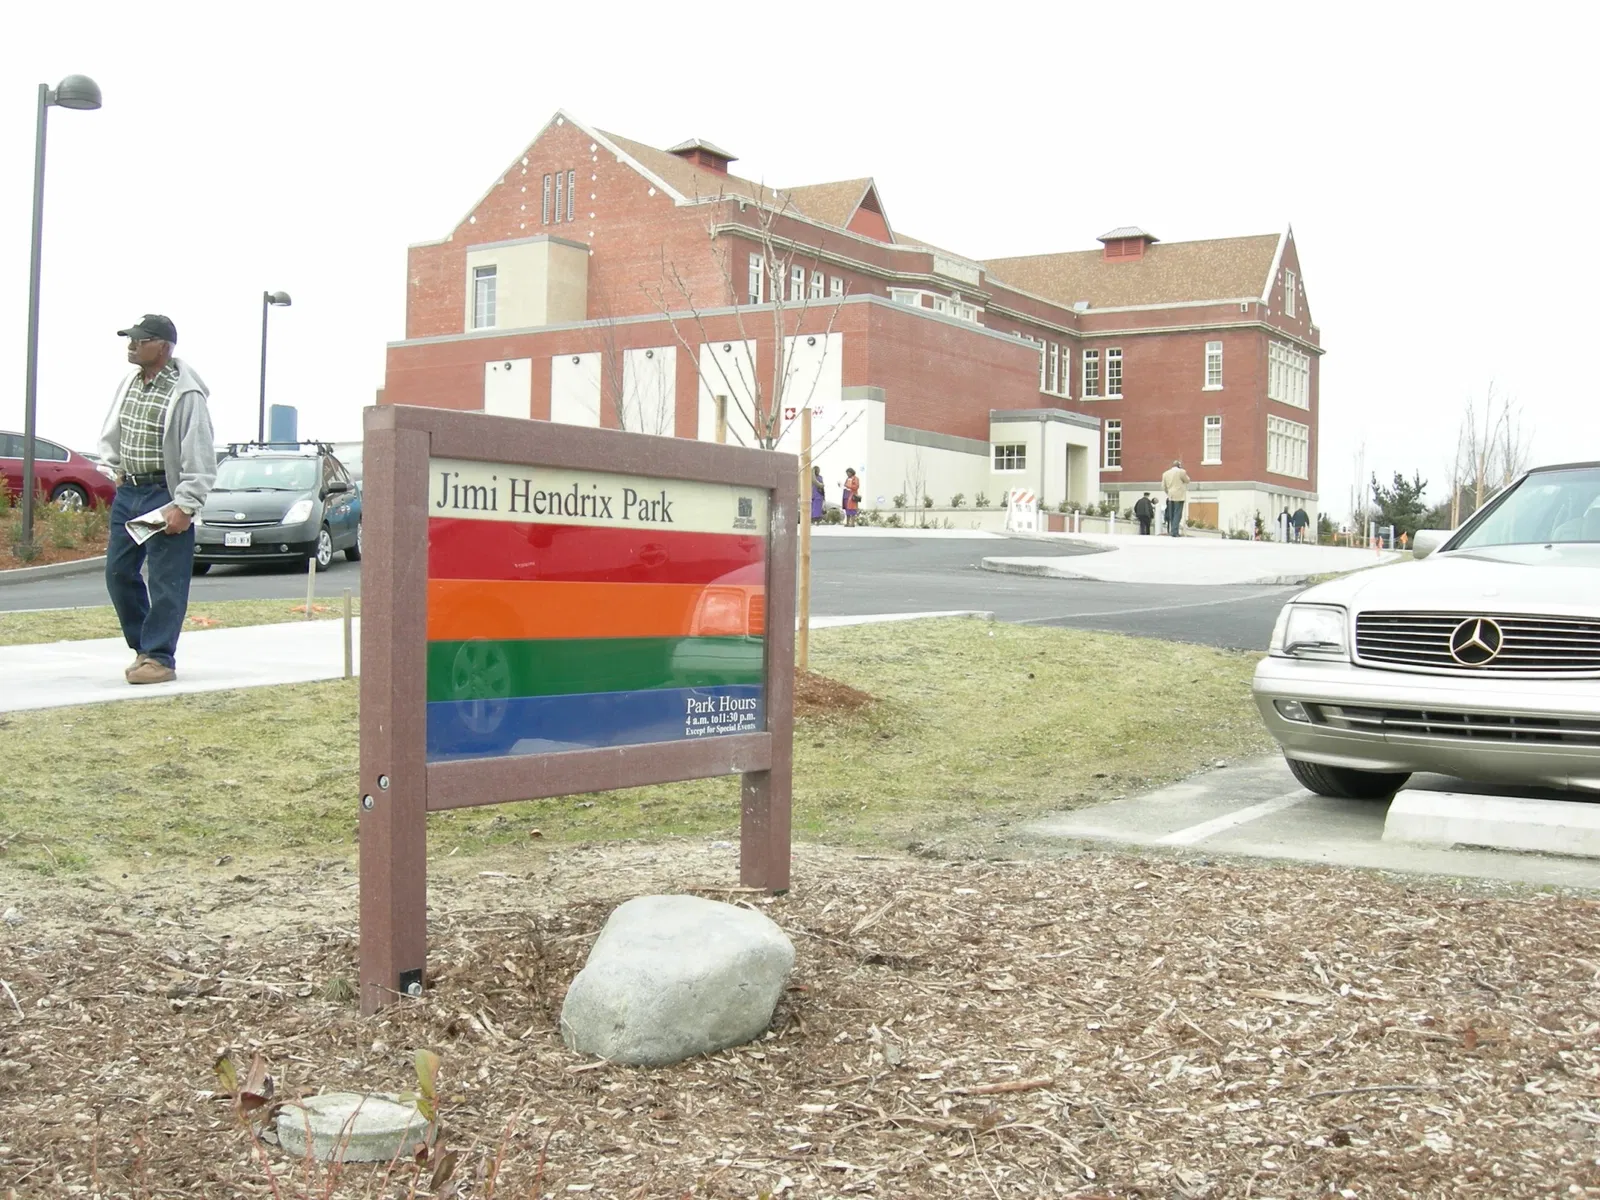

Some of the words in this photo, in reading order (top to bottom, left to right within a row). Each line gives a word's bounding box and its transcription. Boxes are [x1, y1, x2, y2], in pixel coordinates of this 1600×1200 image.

[436, 472, 498, 511] Jimi
[508, 478, 614, 519] Hendrix
[621, 488, 674, 523] Park
[686, 696, 715, 714] Park
[719, 696, 757, 712] Hours
[685, 715, 691, 725] 4
[692, 717, 709, 725] a.m.
[739, 713, 756, 724] p.m.
[685, 727, 706, 736] Except
[706, 725, 716, 733] for
[716, 723, 736, 734] Special
[737, 723, 756, 731] Events
